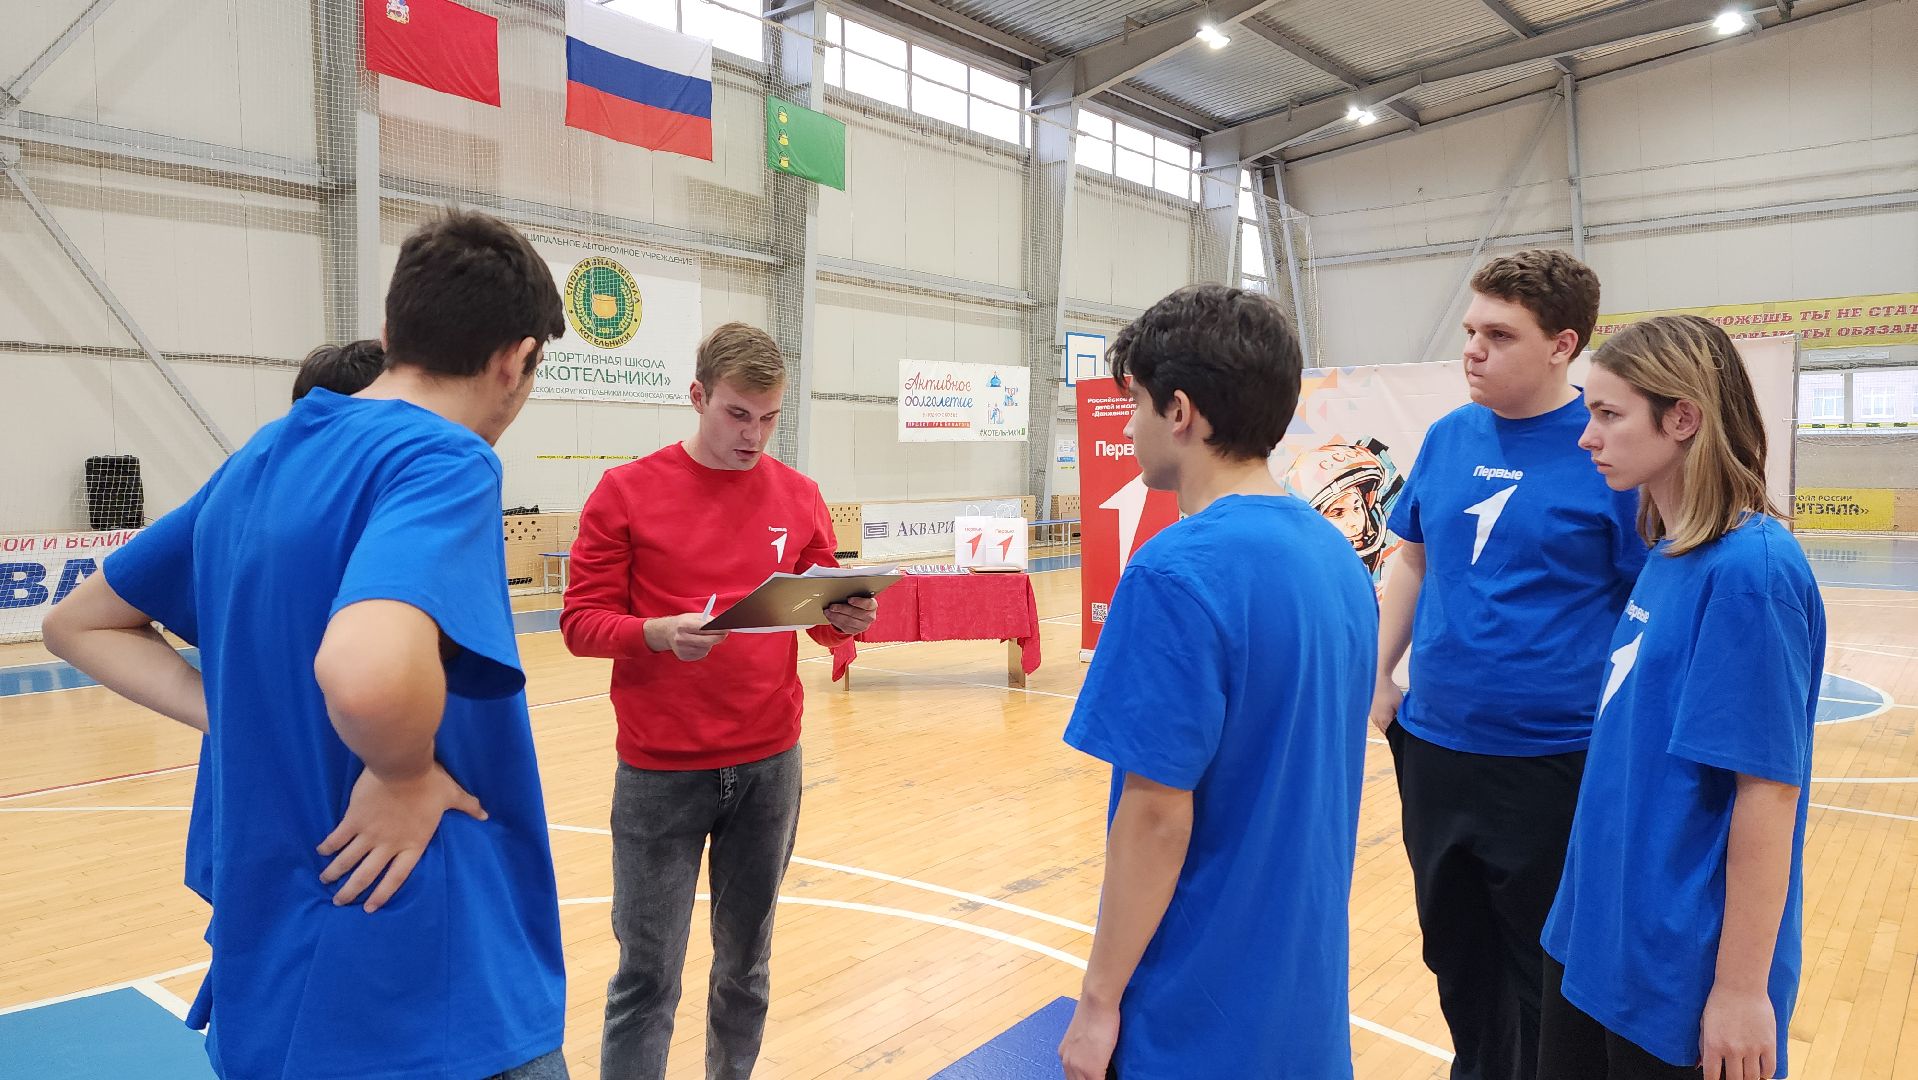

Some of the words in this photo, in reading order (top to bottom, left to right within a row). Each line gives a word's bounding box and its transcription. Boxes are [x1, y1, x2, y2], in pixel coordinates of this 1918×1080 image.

[582, 240, 640, 258] АВТОНОМНОЕ
[641, 251, 693, 266] УЧРЕЖДЕНИЕ
[1800, 309, 1831, 321] ТЫ
[1836, 307, 1863, 319] НЕ
[578, 326, 632, 348] КОТЕЛЬНИКИ
[1800, 327, 1832, 338] ТЫ
[1837, 323, 1918, 337] ОБЯЗАН
[543, 351, 622, 366] СПОРТИВНАЯ
[624, 356, 666, 369] ШКОЛА
[535, 364, 671, 387] «КОТЕЛЬНИКИ»
[904, 372, 972, 392] Активное
[578, 388, 622, 397] КОТЕЛЬНИКИ
[1094, 403, 1115, 411] детей
[1095, 440, 1135, 460] Перв
[1472, 465, 1524, 480] Первые
[897, 520, 955, 537] АКВАРИ
